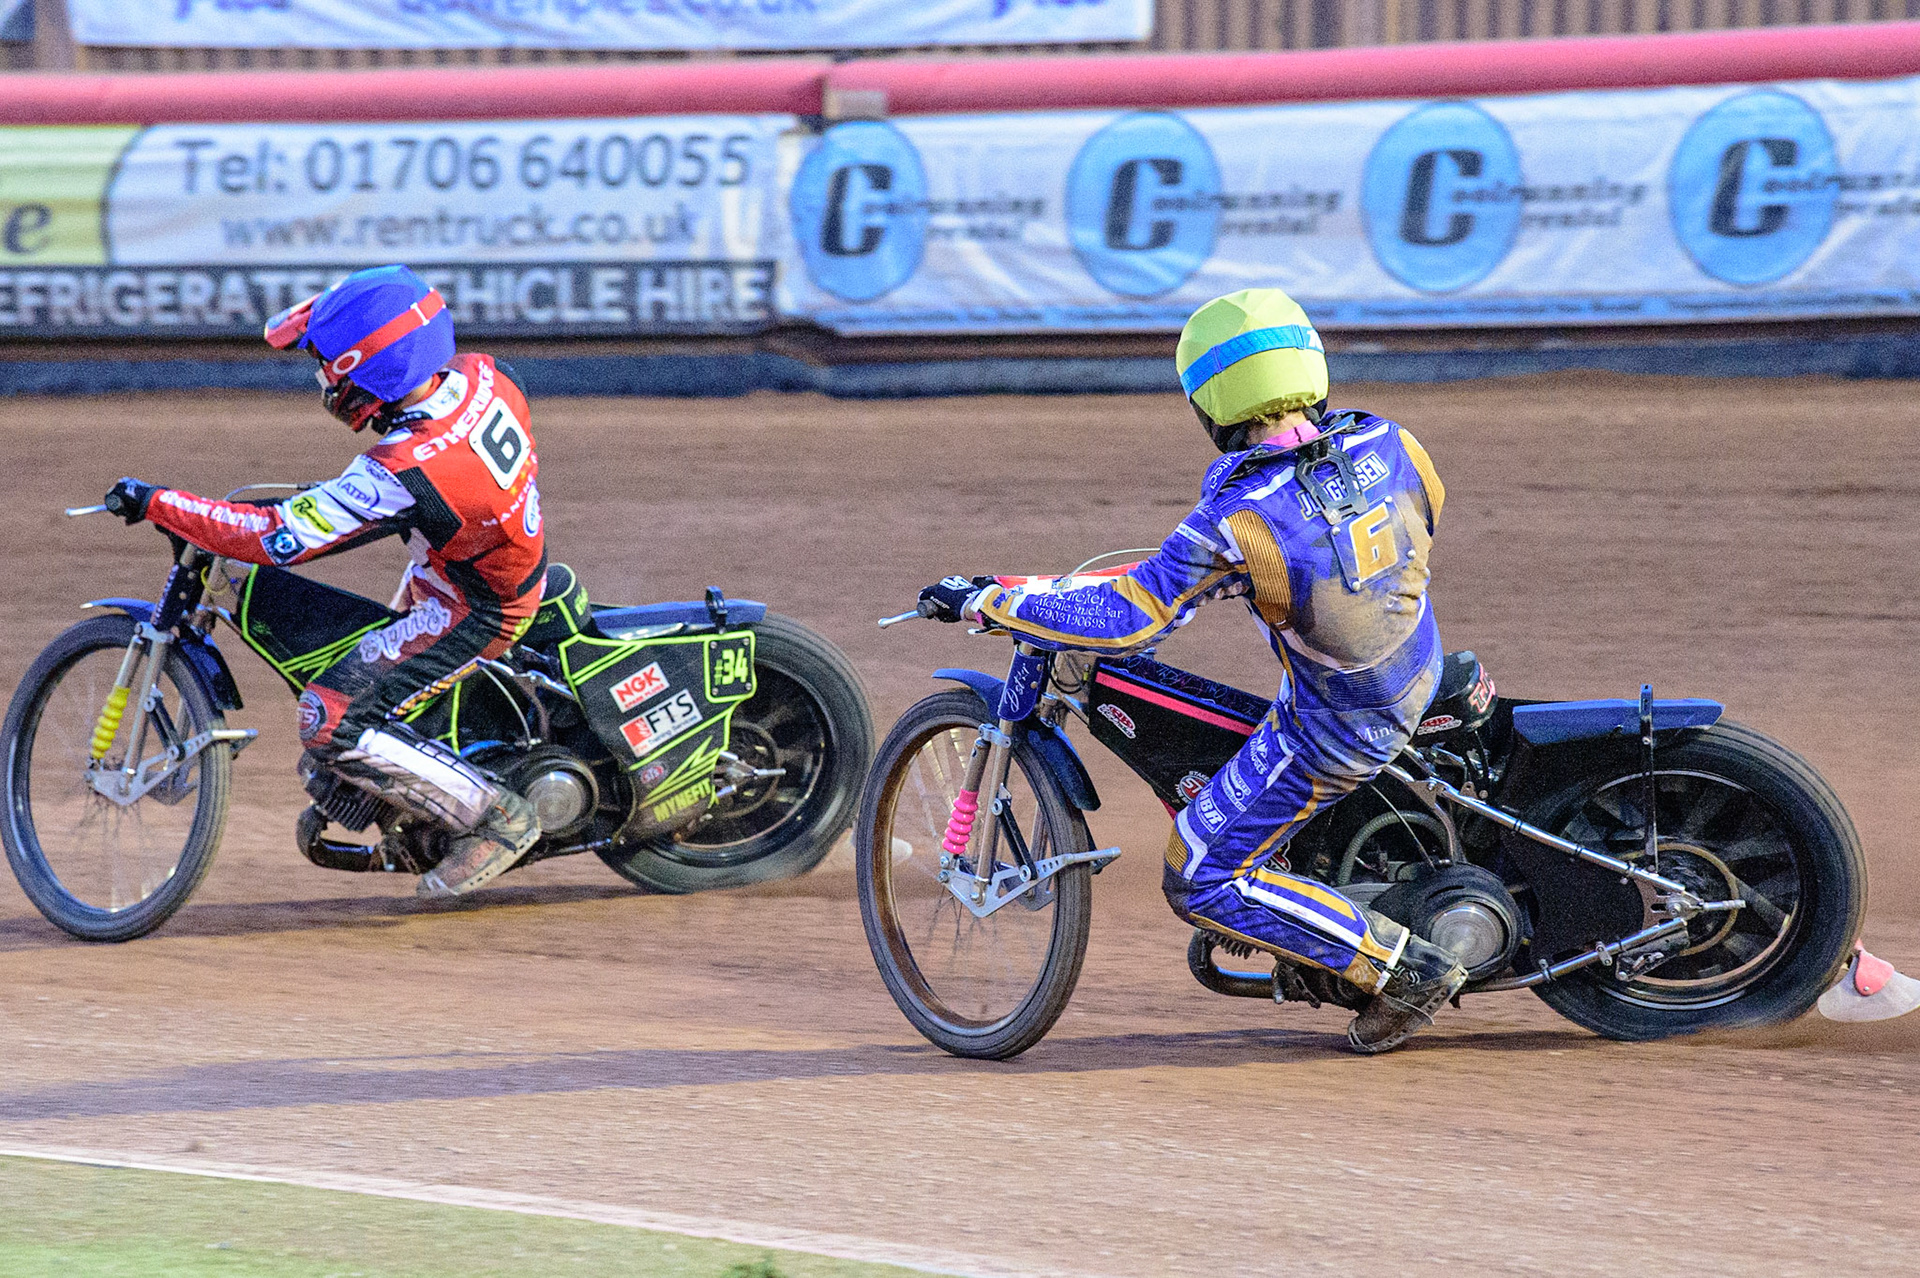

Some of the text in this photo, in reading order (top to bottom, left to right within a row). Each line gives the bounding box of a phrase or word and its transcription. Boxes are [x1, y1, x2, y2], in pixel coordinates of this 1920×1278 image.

[176, 134, 750, 194] Tel: 01706 640055
[222, 203, 700, 250] www.rentruck.co.uk
[0, 267, 768, 326] EFRIGERATE EHICLE HIRE
[413, 361, 494, 462] ETHERIDGE
[481, 409, 522, 475] 6
[1349, 502, 1399, 583] 6
[616, 667, 661, 703] NGK
[714, 648, 749, 685] #34
[645, 693, 694, 733] FTS
